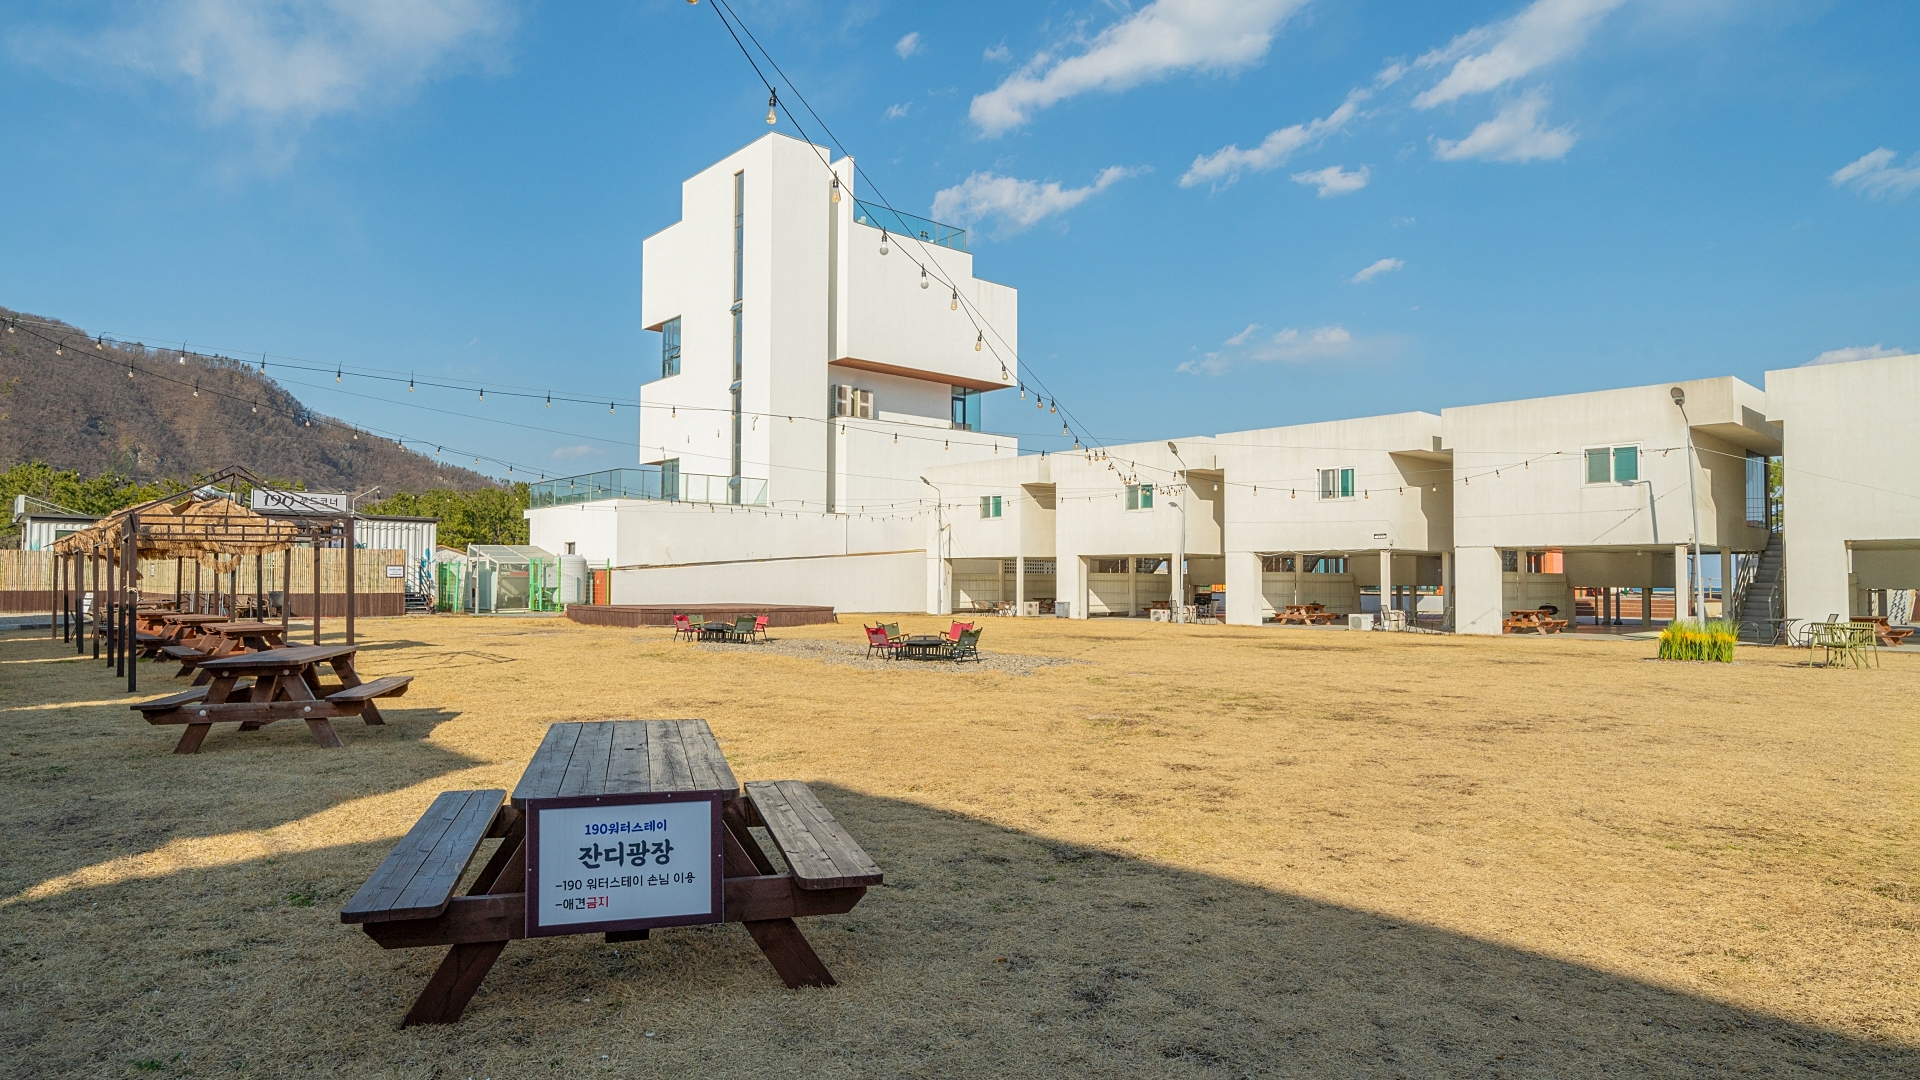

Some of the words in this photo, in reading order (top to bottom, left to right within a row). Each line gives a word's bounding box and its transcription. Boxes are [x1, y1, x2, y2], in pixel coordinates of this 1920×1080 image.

[263, 494, 295, 507] 190
[584, 819, 668, 836] 190워터스테이
[578, 838, 675, 870] 잔디광장
[586, 874, 644, 890] 워터스테이
[647, 873, 670, 886] 손님
[673, 871, 696, 885] 이용
